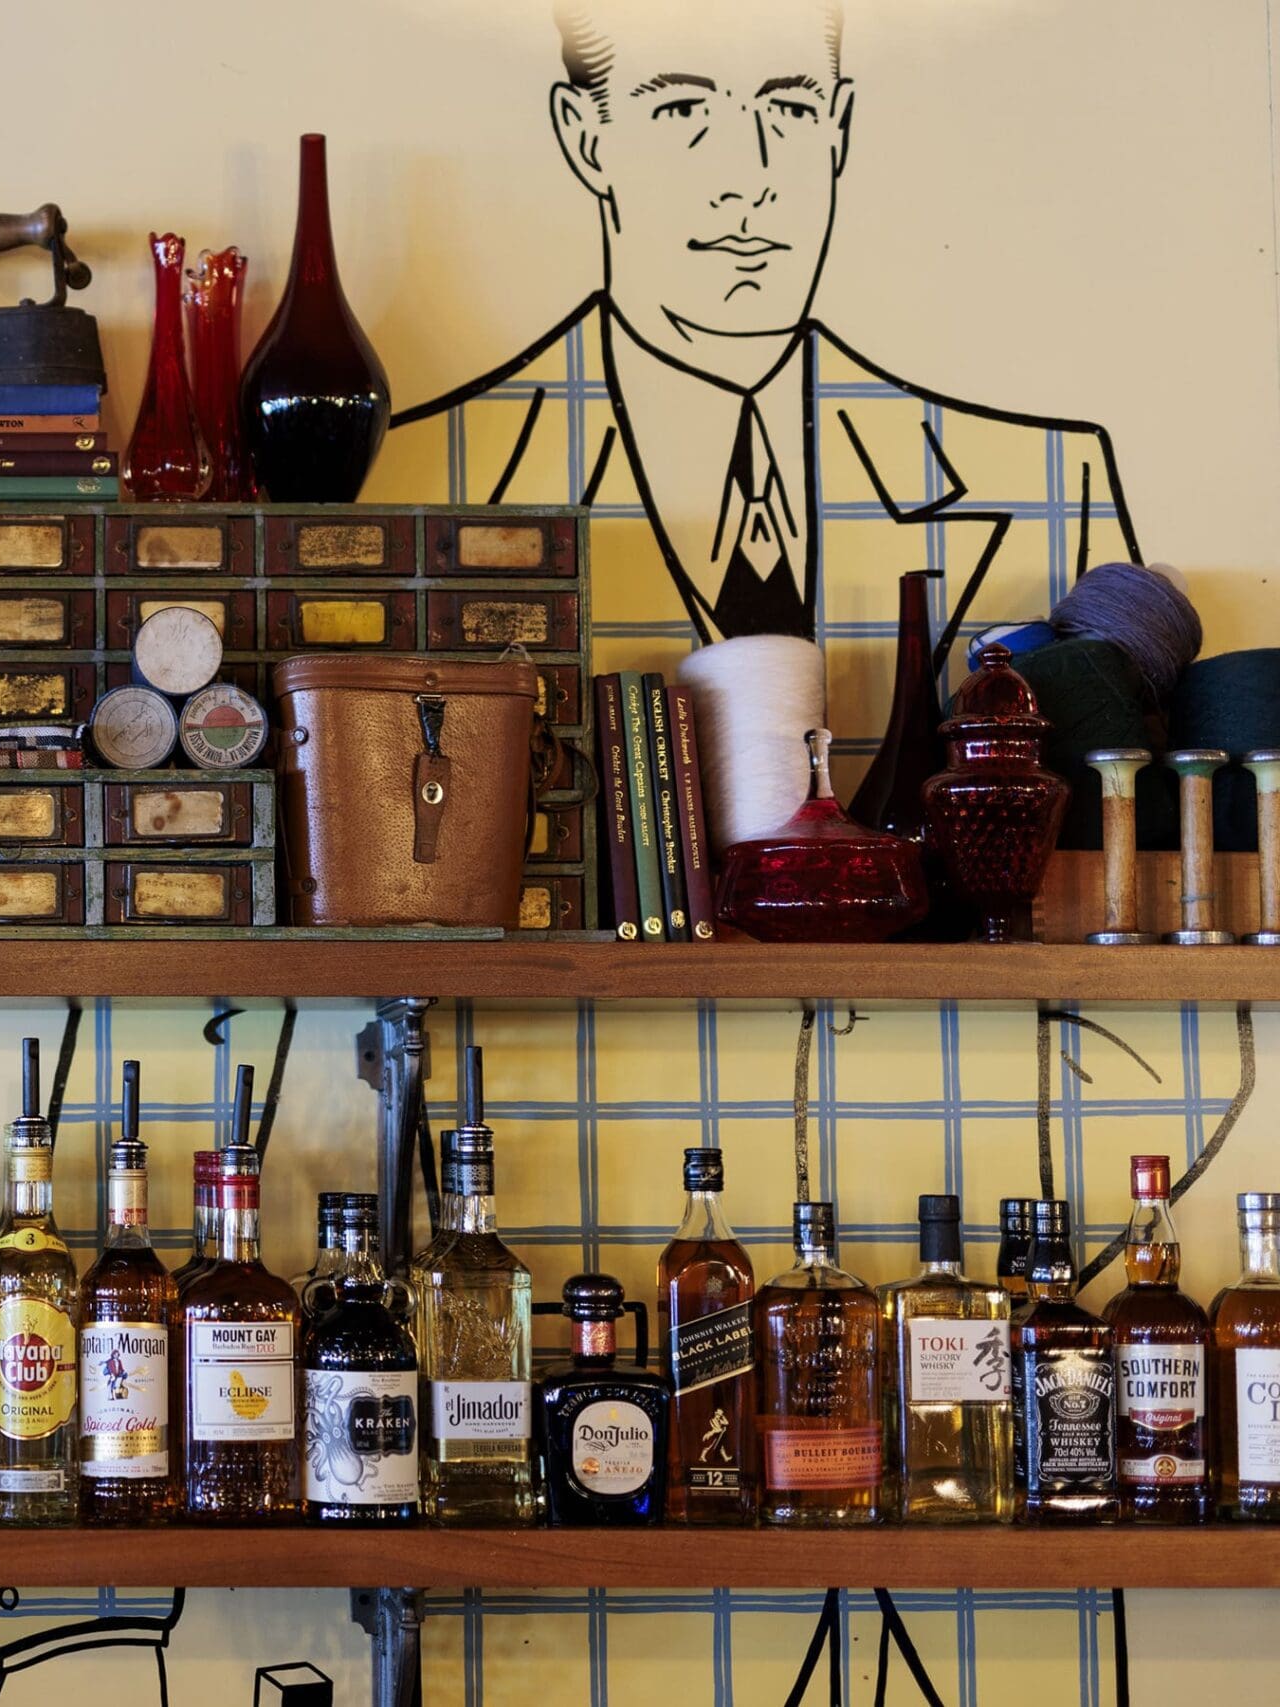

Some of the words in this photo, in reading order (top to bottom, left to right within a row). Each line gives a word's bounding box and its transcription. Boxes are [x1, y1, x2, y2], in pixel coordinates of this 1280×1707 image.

[652, 689, 664, 732] ENGLISH
[656, 736, 668, 780] CRICKET
[661, 790, 671, 840] Christopher
[25, 1233, 35, 1245] 3
[212, 1330, 252, 1342] MOUNT
[256, 1330, 276, 1342] GAY
[680, 1328, 714, 1346] JOHNNIE
[715, 1316, 747, 1331] WALKER
[116, 1333, 166, 1358] Morgan
[256, 1344, 275, 1353] 1703
[672, 1340, 713, 1360] BLACK
[716, 1326, 753, 1345] LABEL
[918, 1337, 964, 1351] TOKI
[920, 1353, 961, 1361] SUNTORY
[5, 1361, 48, 1381] Club
[920, 1362, 955, 1370] WHISKY
[1121, 1358, 1200, 1377] SOUTHERN
[1035, 1372, 1067, 1397] JACK
[1067, 1368, 1113, 1397] DANIEL'S
[220, 1386, 272, 1397] ECLIPSE
[1127, 1381, 1197, 1398] COMFORT
[446, 1399, 453, 1411] el
[449, 1394, 522, 1426] Jimador
[1063, 1400, 1086, 1409] No.7
[84, 1415, 122, 1432] Spiced
[125, 1416, 157, 1432] Gold
[355, 1418, 410, 1428] KRAKEN
[1145, 1413, 1182, 1424] Original
[1049, 1419, 1102, 1431] Tennessee
[1050, 1437, 1100, 1446] WHISKEY
[794, 1448, 837, 1457] BULLEIT
[1054, 1448, 1069, 1456] 70cl
[1070, 1448, 1085, 1456] 40%
[604, 1465, 643, 1473] AÑEJO
[707, 1471, 723, 1485] 12
